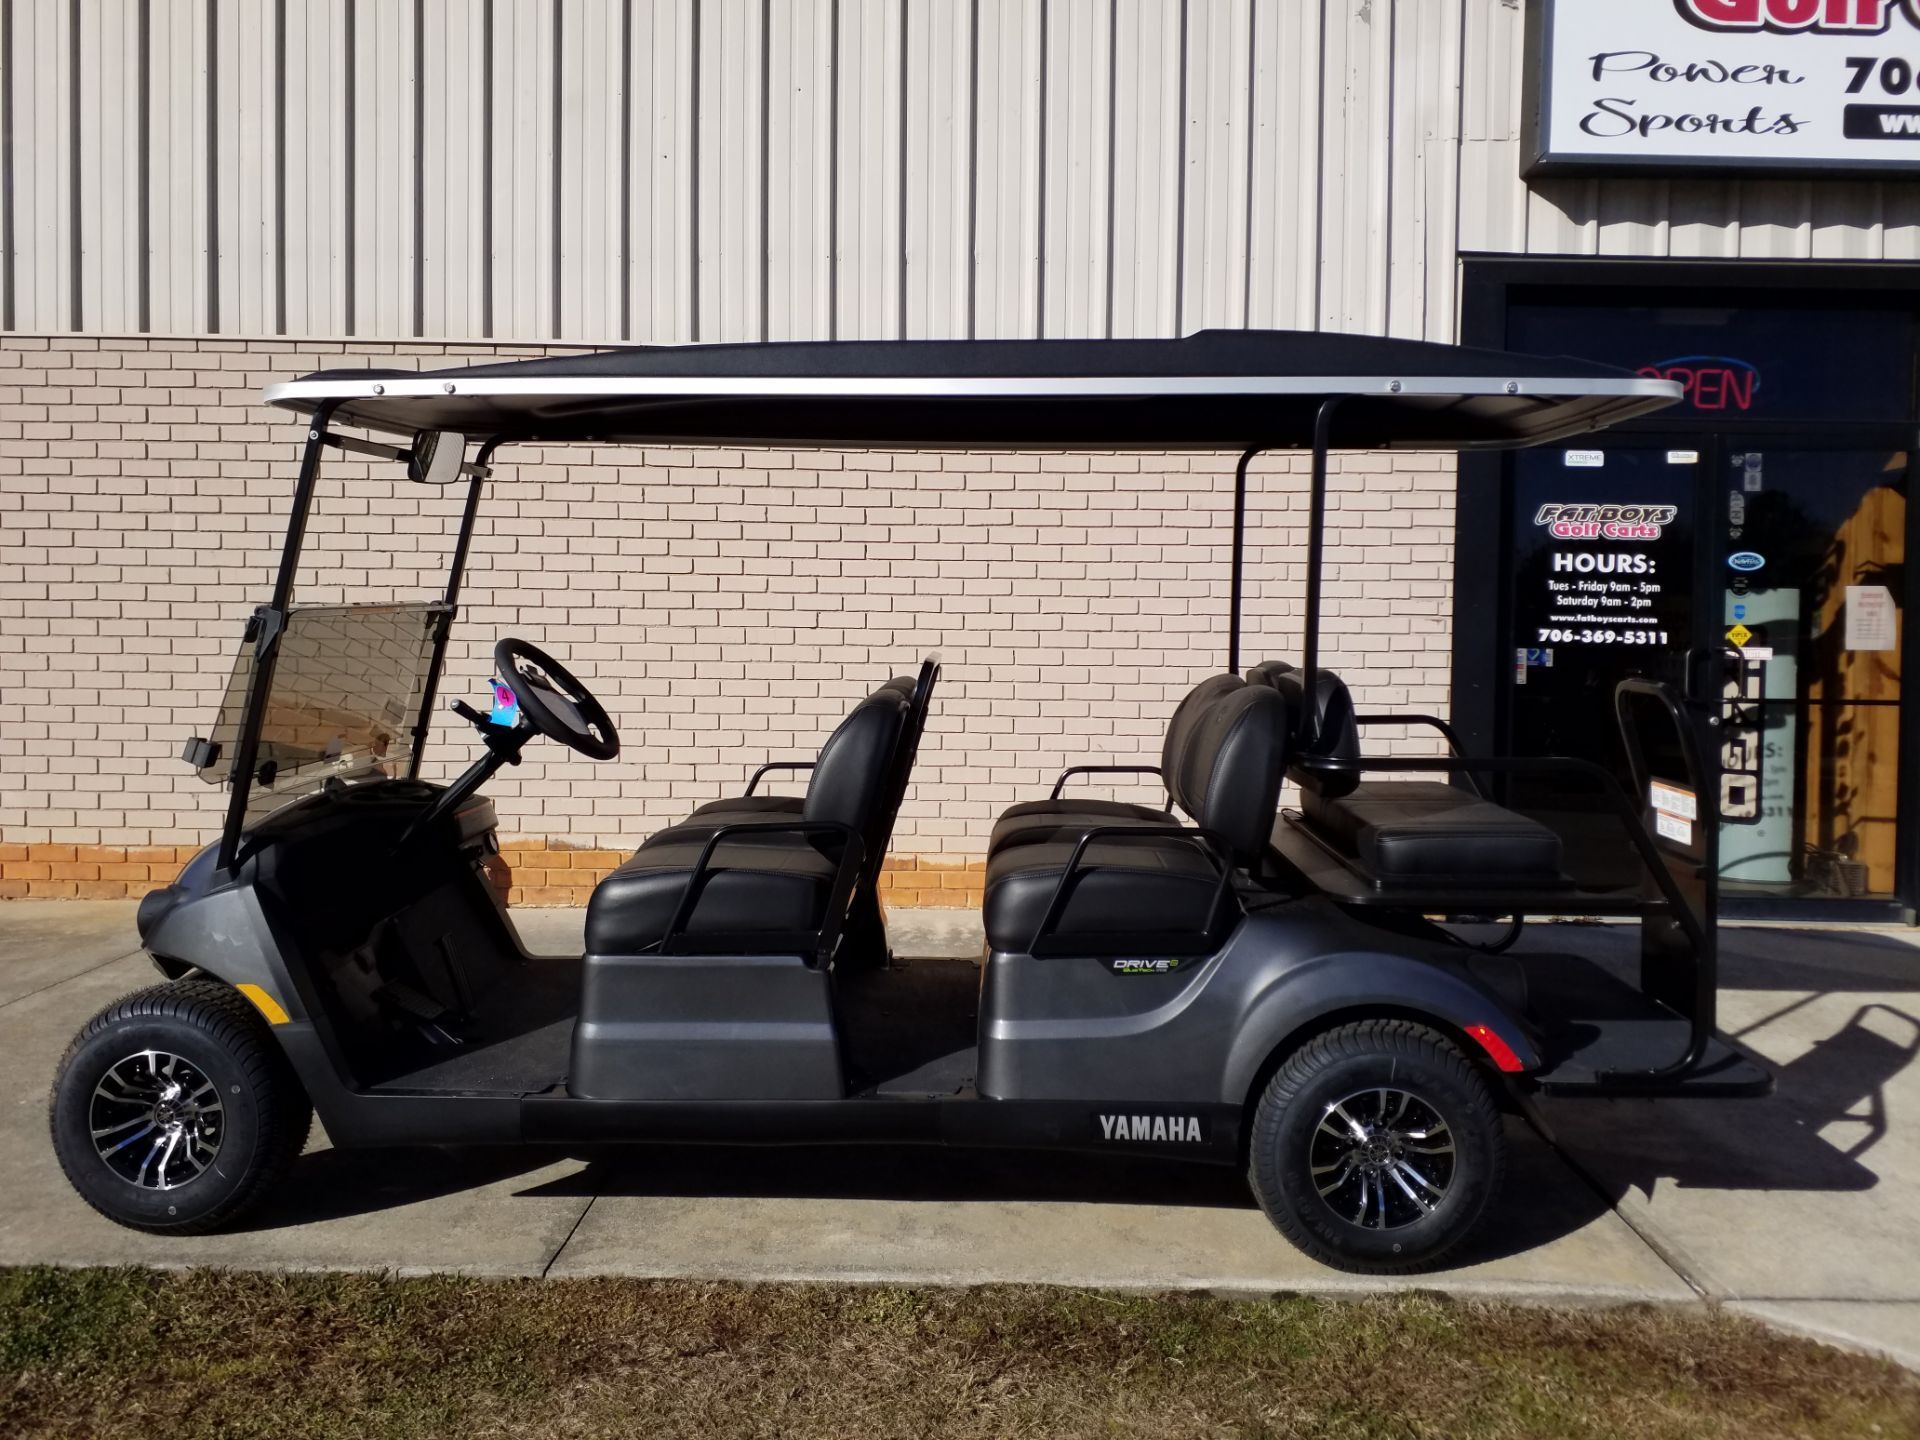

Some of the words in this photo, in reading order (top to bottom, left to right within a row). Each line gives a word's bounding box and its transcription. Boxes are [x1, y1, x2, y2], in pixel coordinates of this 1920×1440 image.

[1588, 50, 1806, 84] Power
[1844, 56, 1920, 96] 70
[1579, 97, 1811, 137] Sports
[1637, 367, 1754, 410] PEN
[1538, 505, 1597, 523] FAT
[1598, 505, 1675, 523] BOYS
[1553, 522, 1600, 538] Golf
[1604, 523, 1659, 539] Carts
[1553, 553, 1656, 574] HOURS:
[1548, 580, 1570, 591] Tues
[1578, 580, 1608, 594] Friday
[1610, 581, 1631, 592] 9am
[1640, 582, 1661, 595] 5pm
[1556, 595, 1599, 608] Saturday
[1601, 596, 1622, 607] 9am
[1631, 597, 1652, 609] 2pm
[1550, 614, 1658, 624] www.fatboyscarts.com
[1538, 628, 1668, 645] 706-369-5311
[502, 689, 510, 702] 4
[1113, 959, 1170, 969] DRIVE
[1100, 1114, 1202, 1142] YAMAHA
